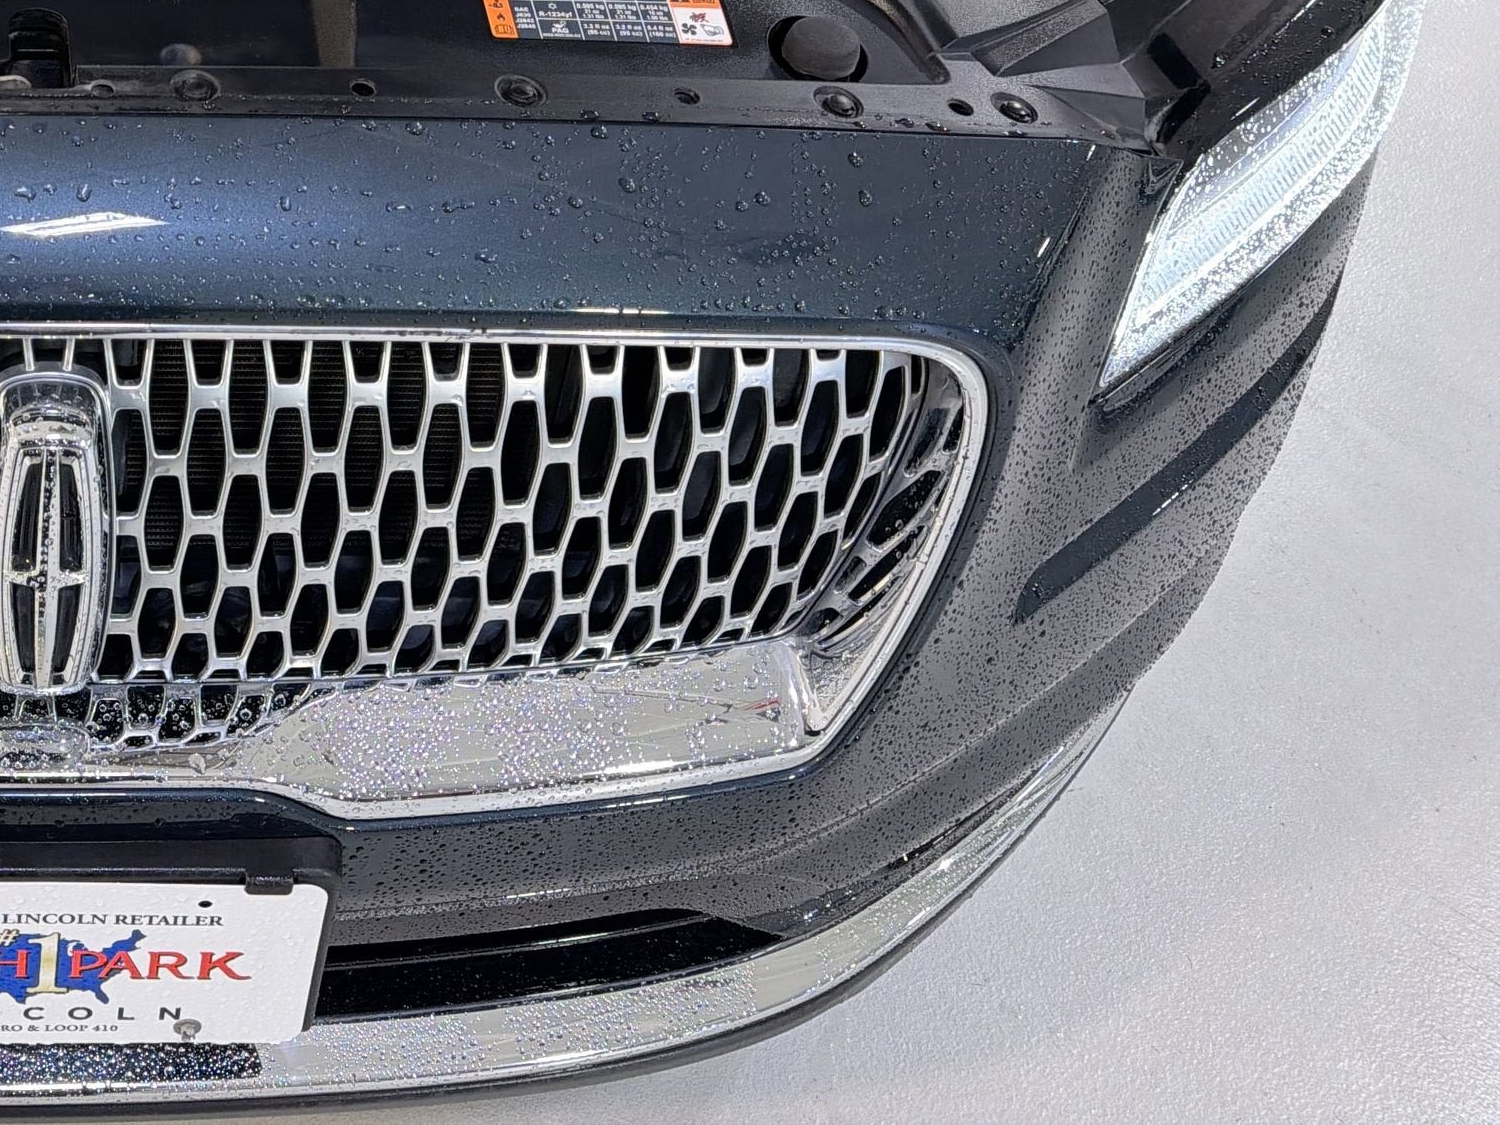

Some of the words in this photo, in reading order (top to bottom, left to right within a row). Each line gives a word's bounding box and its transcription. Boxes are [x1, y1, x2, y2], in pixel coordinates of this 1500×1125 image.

[538, 11, 573, 19] R-1234yf
[2, 913, 108, 925] LINCOLN
[114, 914, 223, 926] RETAILER
[68, 949, 252, 980] PARK
[27, 1024, 39, 1032] &
[43, 1024, 89, 1032] LOOP
[92, 1024, 118, 1032] 410
